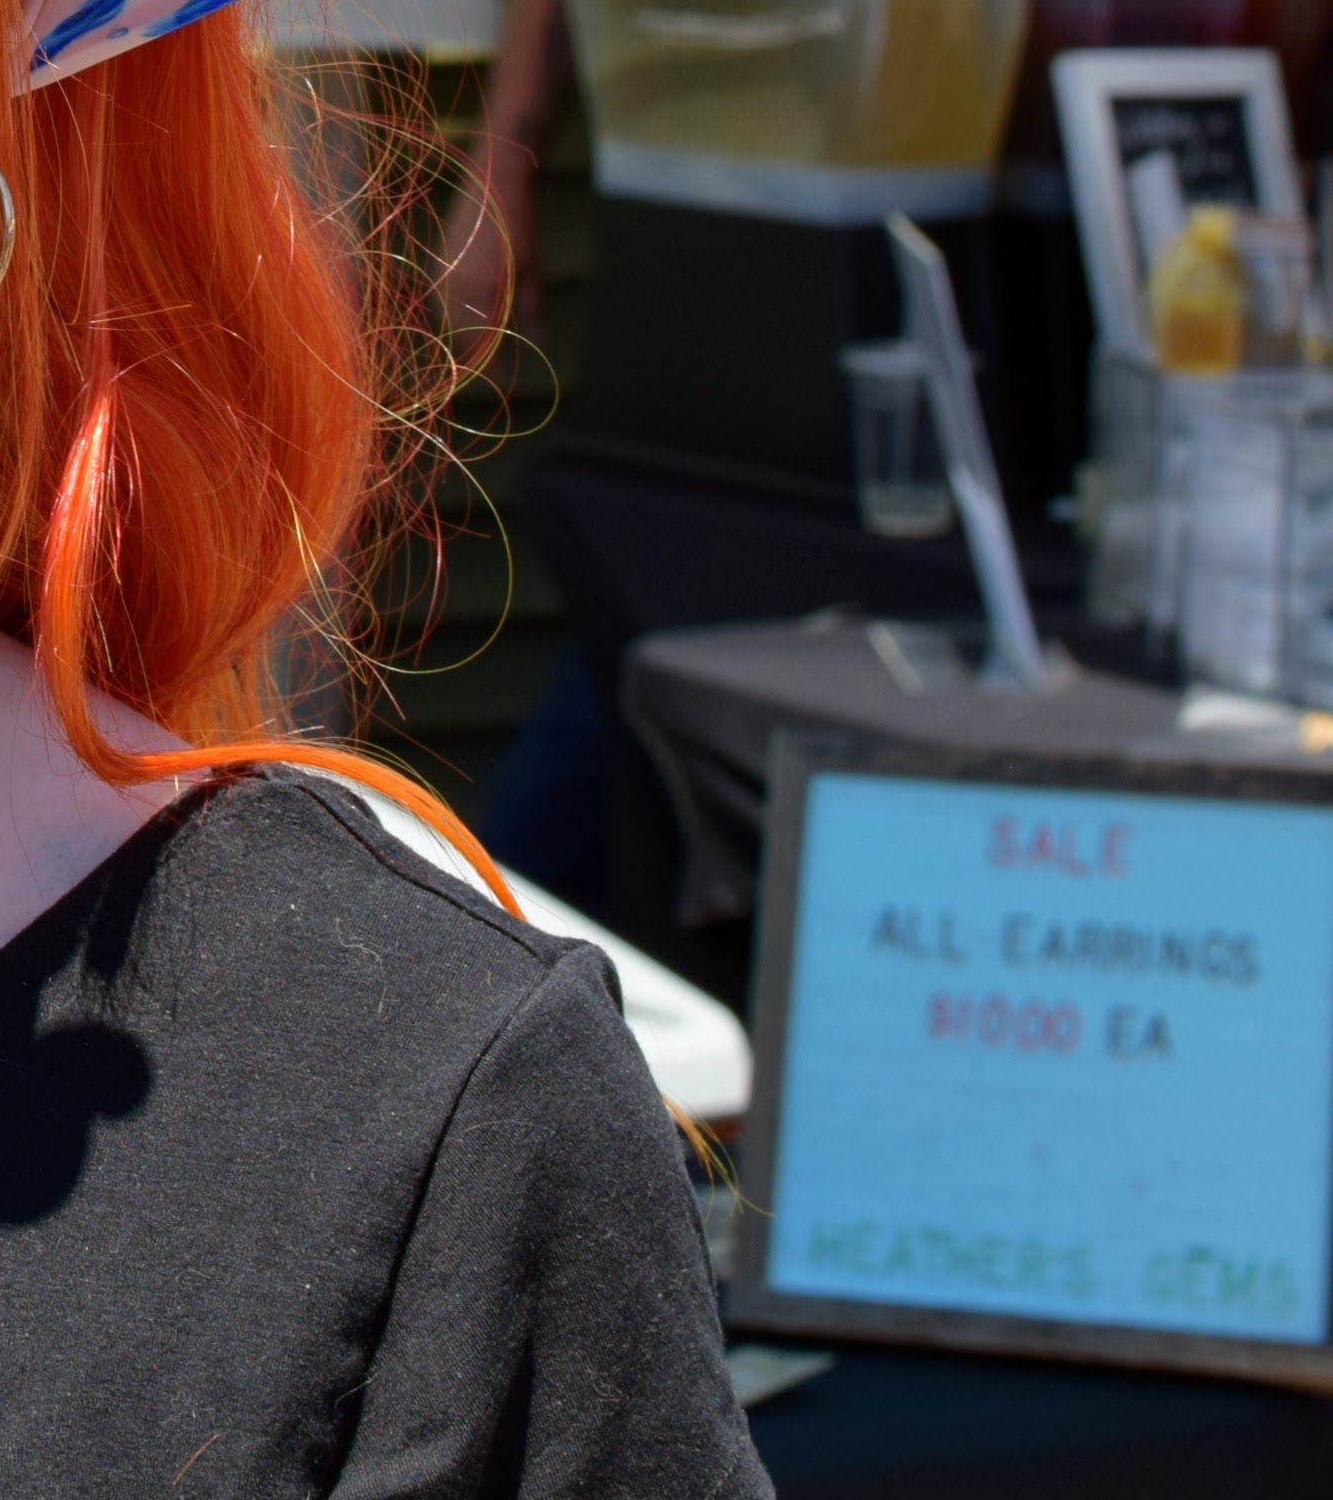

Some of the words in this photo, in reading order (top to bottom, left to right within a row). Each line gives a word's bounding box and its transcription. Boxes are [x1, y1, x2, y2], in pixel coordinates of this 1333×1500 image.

[989, 815, 1132, 878] SALE
[870, 904, 966, 966] ALL
[1002, 912, 1260, 986] EARRINGS
[1105, 1004, 1171, 1060] EA
[1145, 1245, 1299, 1318] GEMS
